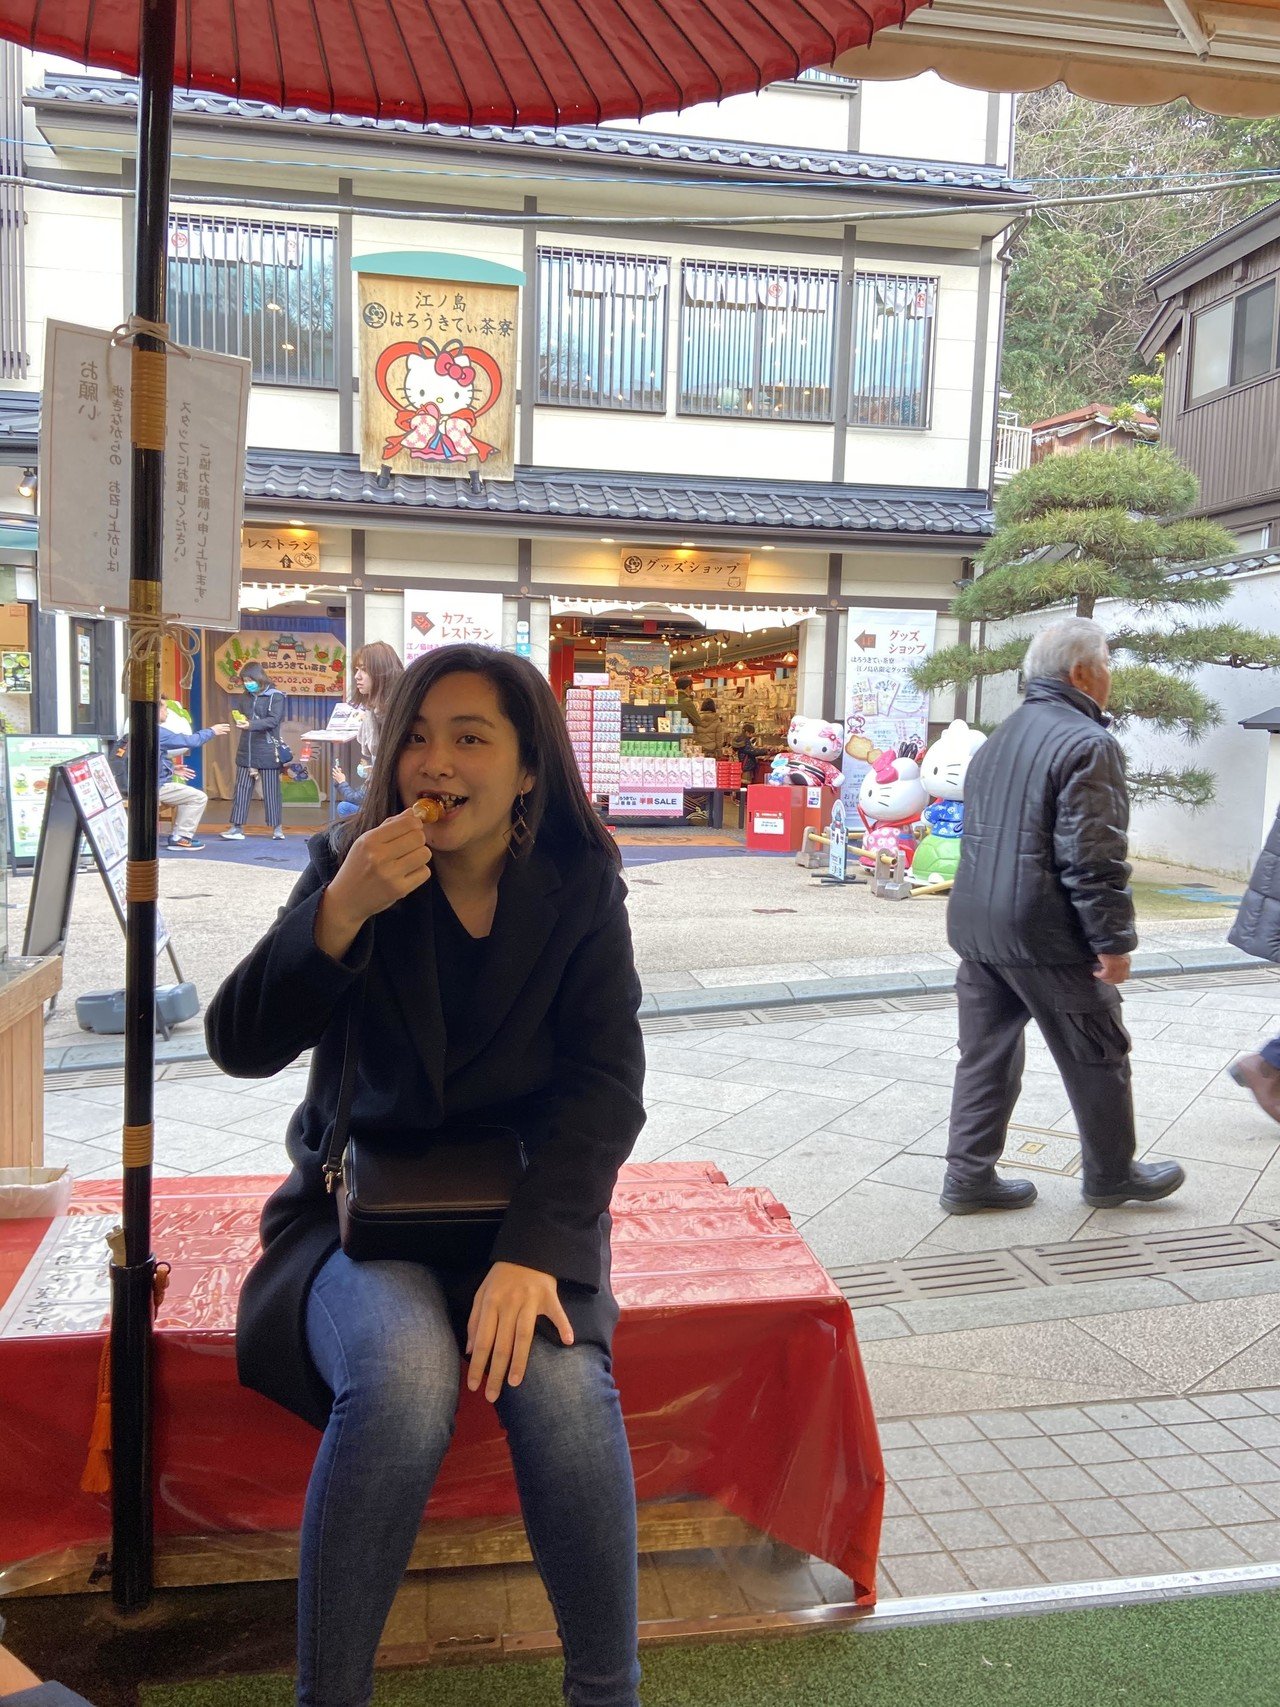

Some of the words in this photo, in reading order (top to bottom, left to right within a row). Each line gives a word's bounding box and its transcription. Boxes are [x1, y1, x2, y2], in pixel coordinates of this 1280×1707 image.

[416, 290, 467, 313] 江ノ島
[390, 311, 514, 337] はろうきてぃ茶寮
[247, 538, 312, 551] レストラン
[646, 558, 741, 574] グッズショップ
[442, 612, 474, 625] カフェ
[442, 627, 495, 640] レストラン
[889, 630, 920, 642] グッズ
[889, 643, 927, 655] ショップ
